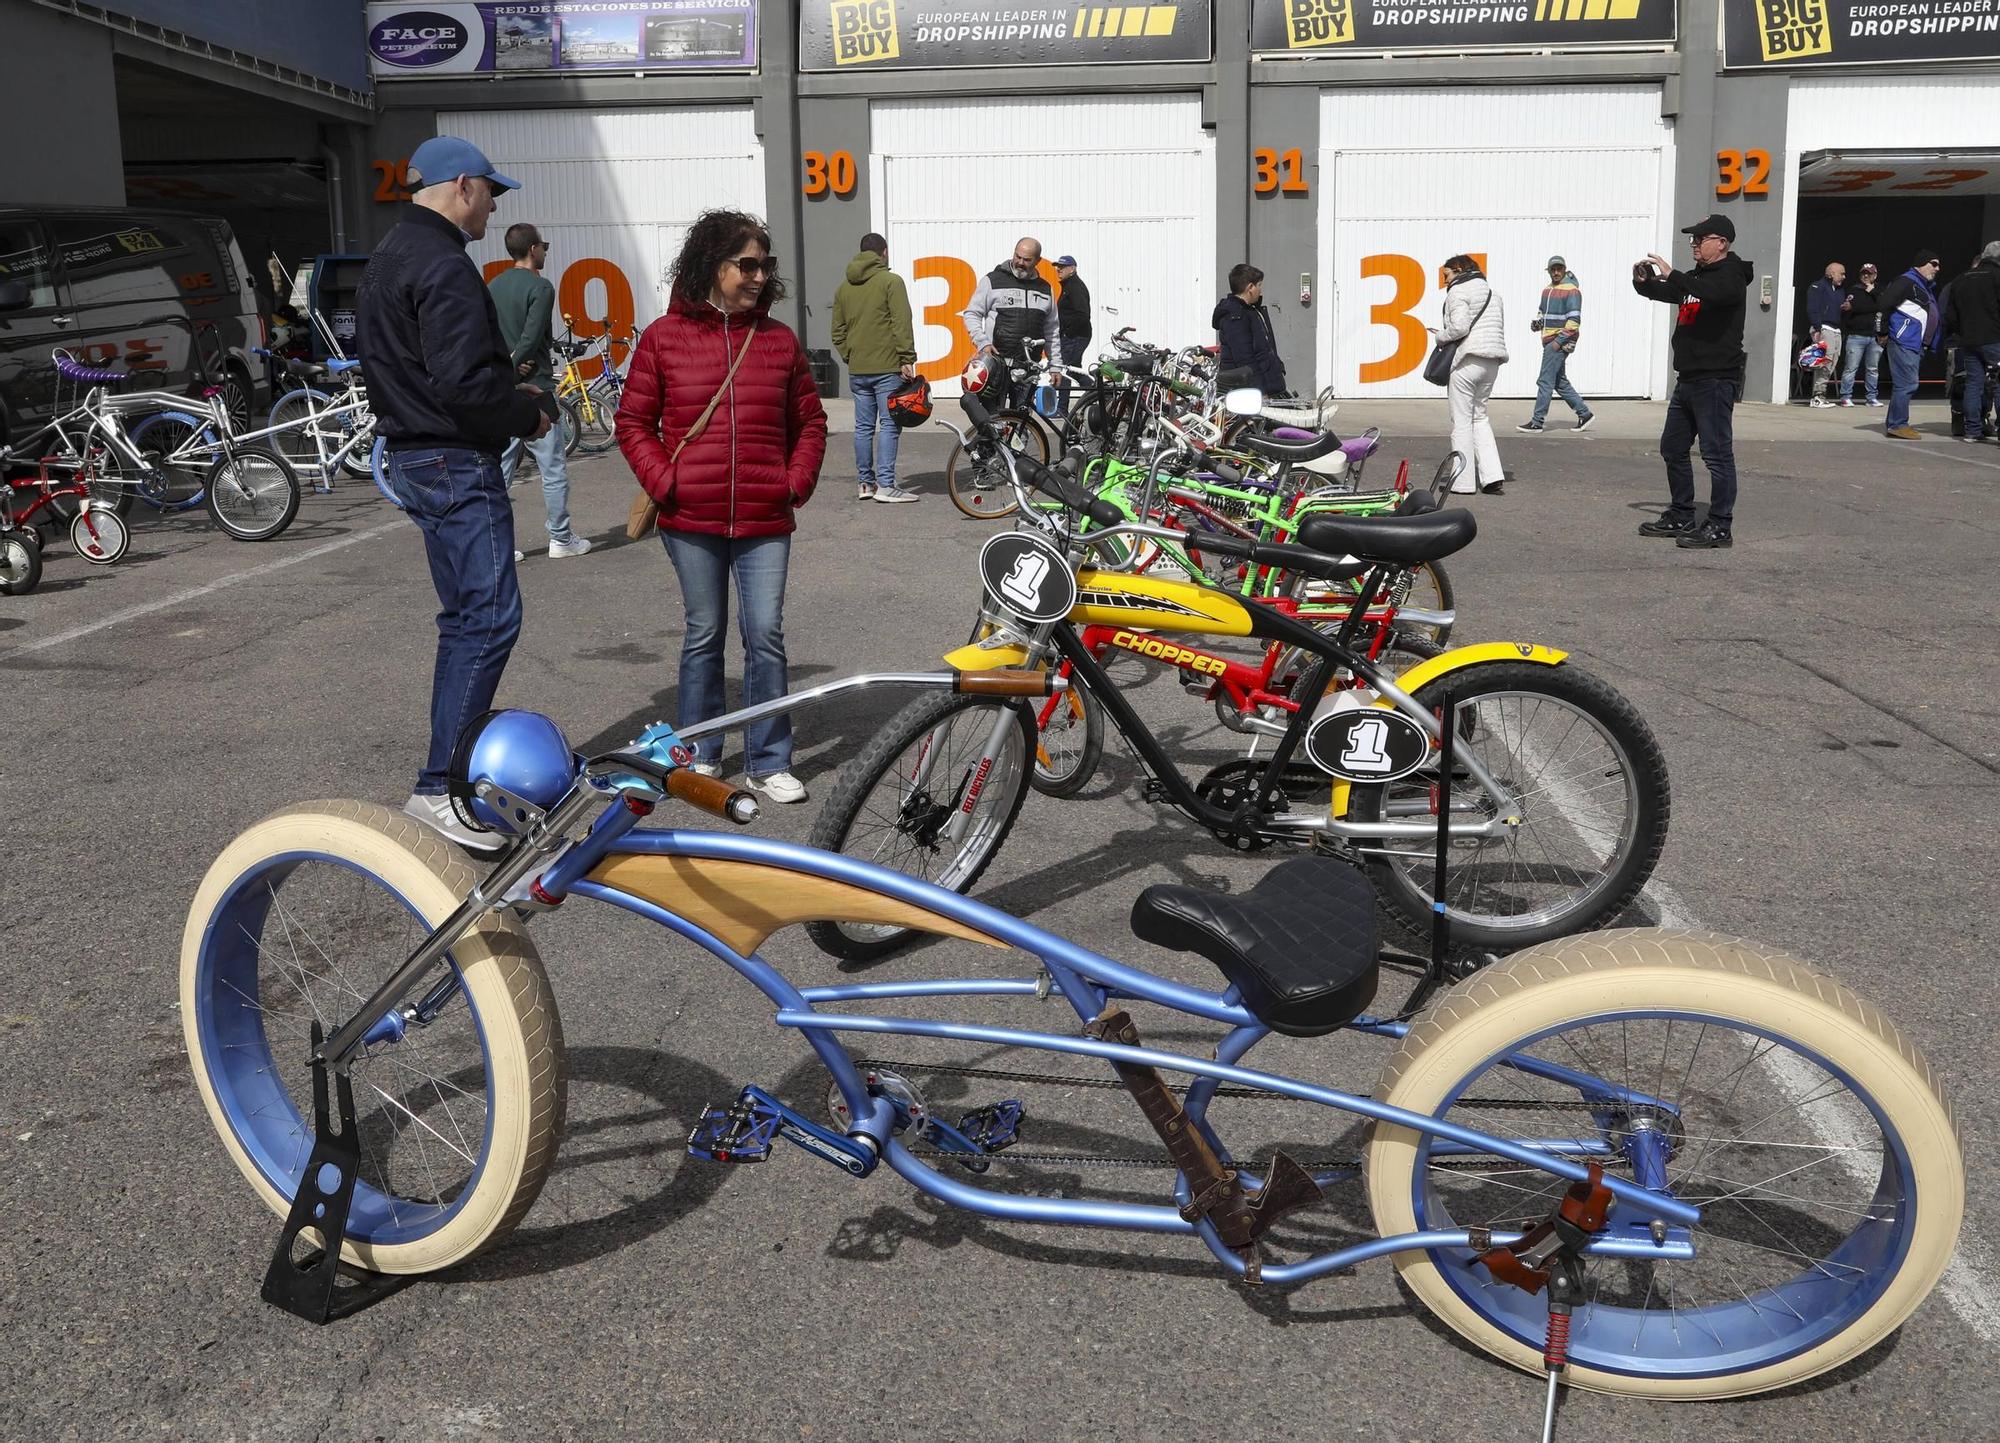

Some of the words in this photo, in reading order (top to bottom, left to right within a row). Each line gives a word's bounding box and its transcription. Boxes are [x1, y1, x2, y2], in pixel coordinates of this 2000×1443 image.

[494, 6, 527, 15] RED
[529, 5, 551, 14] DE
[552, 2, 649, 13] ESTACIONES
[650, 1, 673, 10] DE
[675, 0, 750, 9] SERVICIO
[916, 11, 990, 24] EUROPEAN
[994, 10, 1048, 22] LEADER
[1051, 9, 1067, 20] IN
[1372, 6, 1528, 26] DROPSHIPPING
[1849, 3, 1929, 17] EUROPEAN
[1934, 0, 1992, 14] LEADER
[381, 27, 456, 40] FACE
[916, 23, 1067, 42] DROPSHIPPING
[1292, 13, 1347, 42] BUY
[1766, 24, 1824, 55] BUY
[1850, 14, 2000, 37] DROPSHIPPIN
[379, 42, 458, 51] PETROLEUM
[839, 30, 893, 59] BUY
[803, 151, 856, 194] 30
[1254, 147, 1309, 193] 31
[1715, 149, 1772, 196] 32
[913, 256, 1062, 382] 3
[1000, 550, 1050, 613] 1
[1112, 630, 1228, 677] CHOPPER
[1340, 718, 1393, 772] 1
[968, 757, 993, 799] BICYCLES
